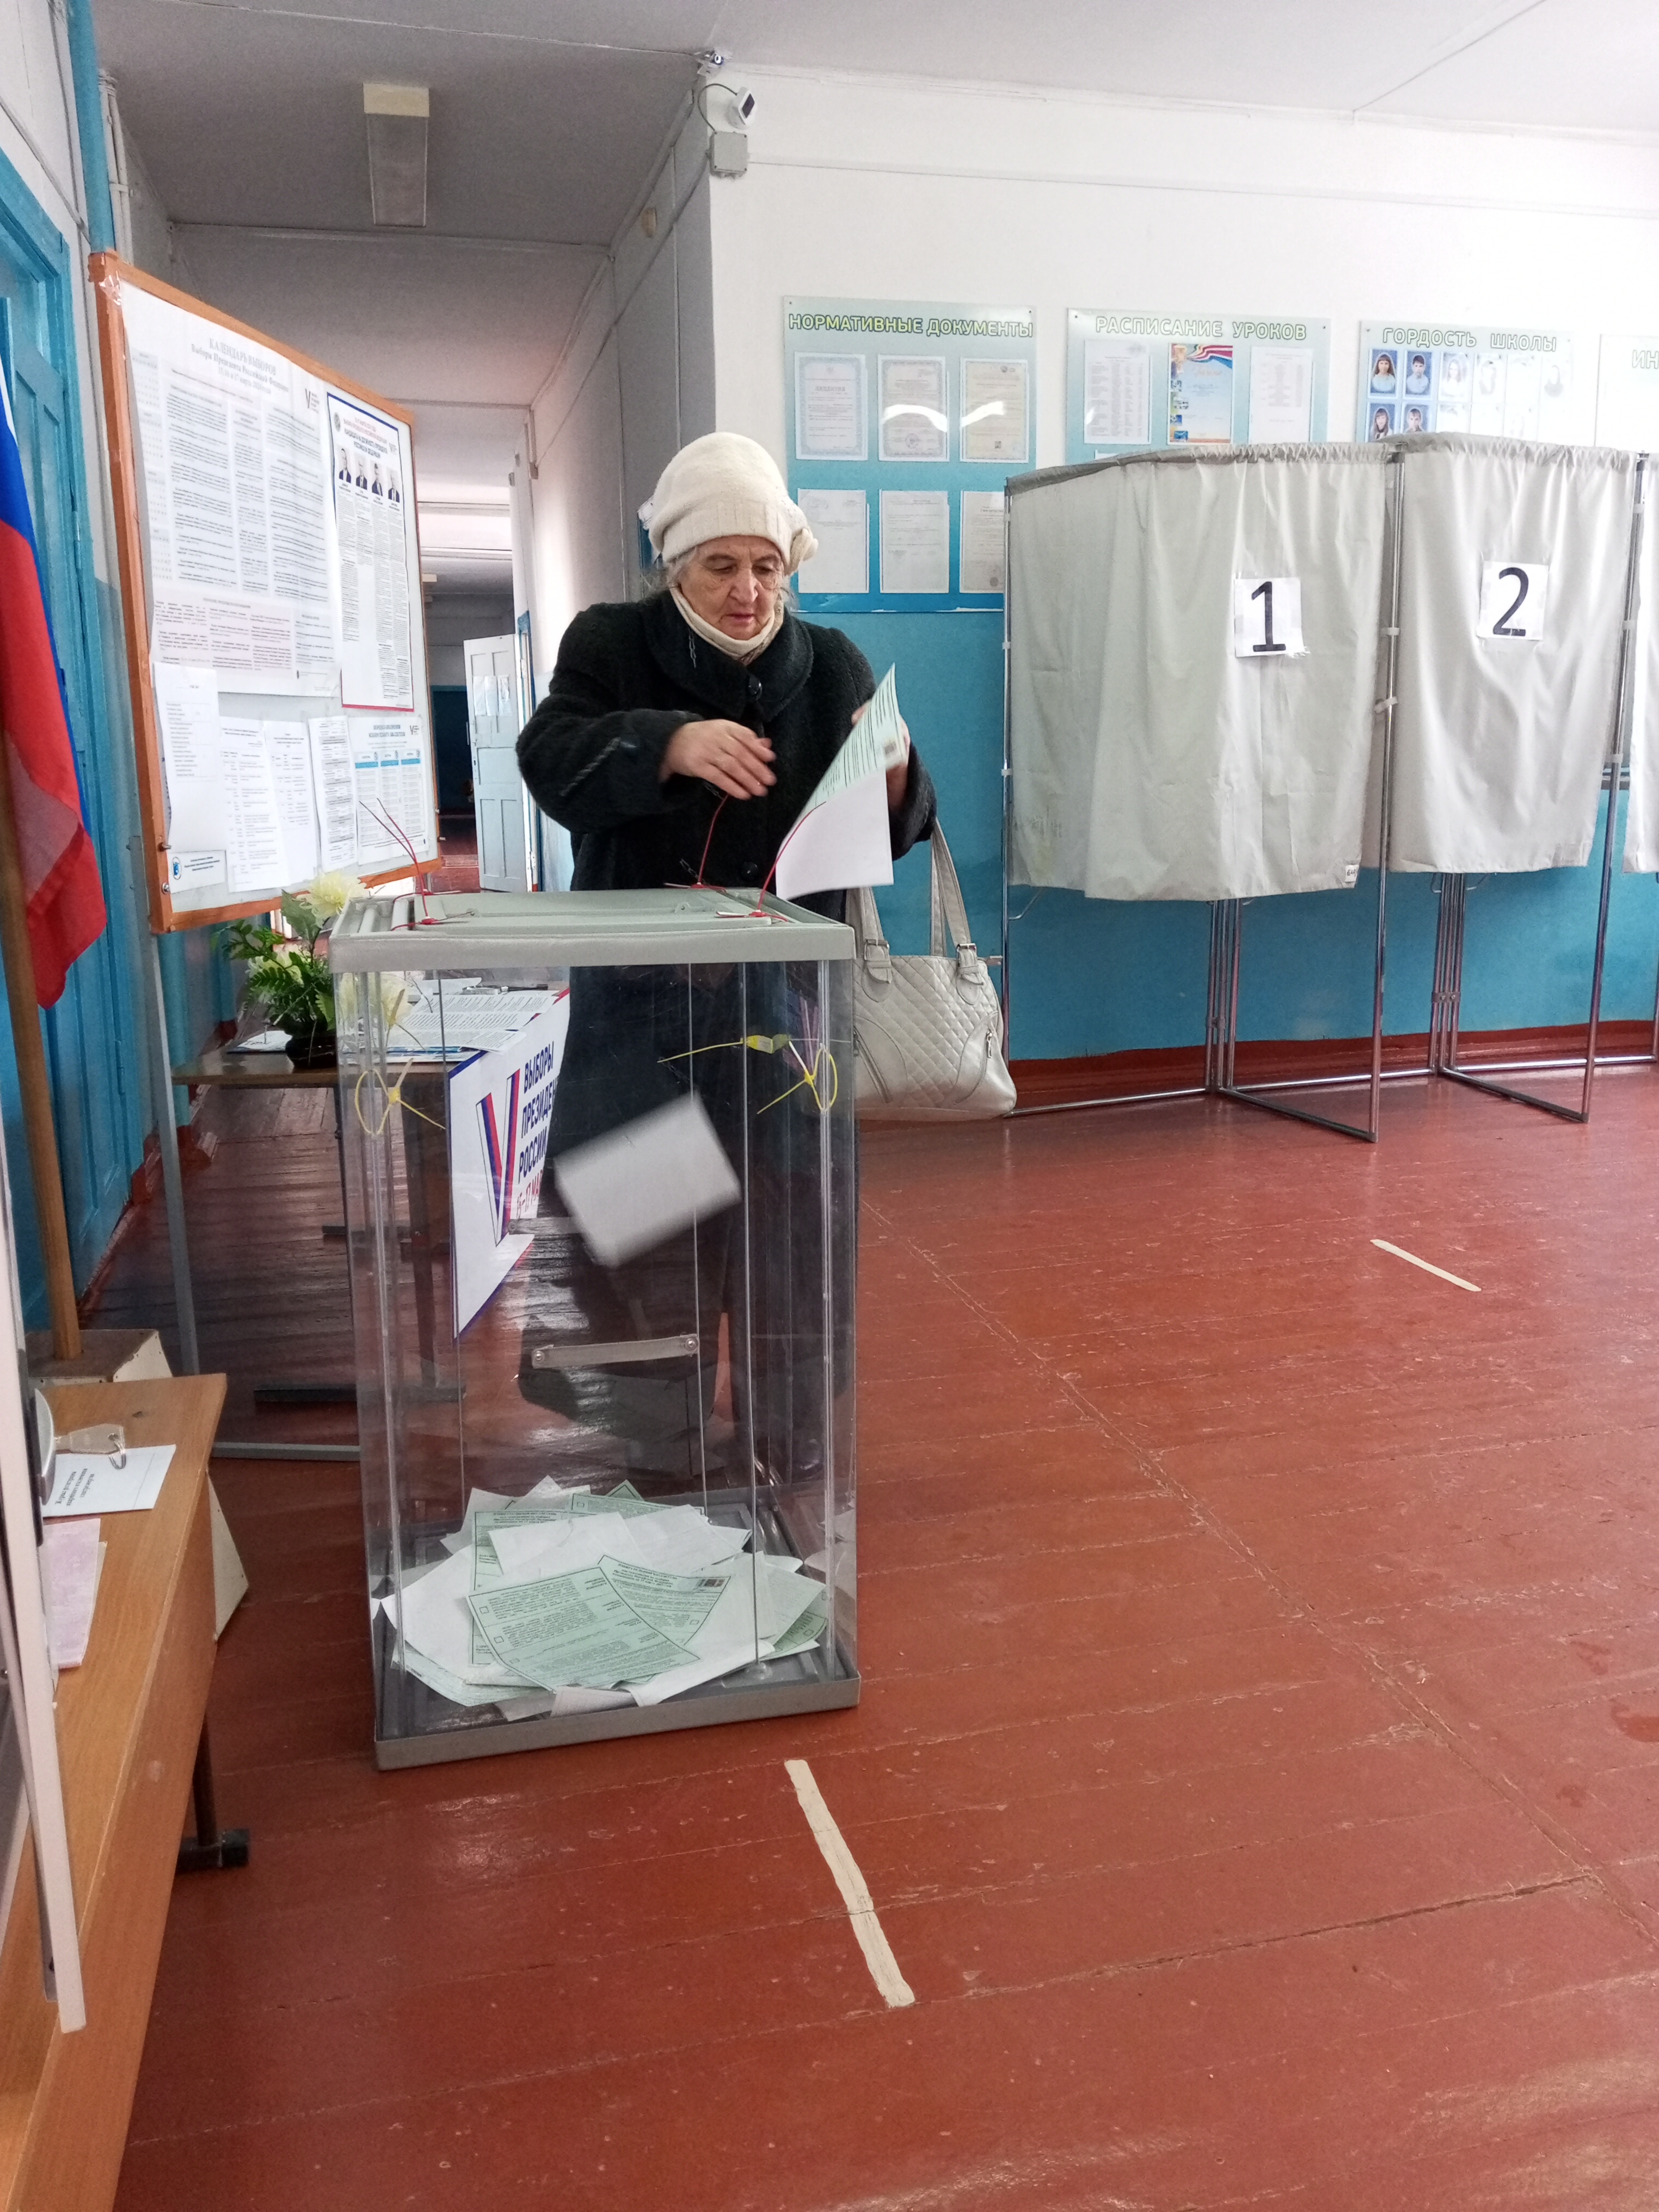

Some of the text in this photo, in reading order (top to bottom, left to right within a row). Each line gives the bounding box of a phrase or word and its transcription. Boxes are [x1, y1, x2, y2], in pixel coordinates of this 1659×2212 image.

[789, 314, 1033, 337] НОРМАТИВНЫЕ ДОКУМЕНТЫ
[1096, 316, 1307, 340] РАСПИСАНИЕ УРОКОВ
[1382, 328, 1557, 352] ГОРДОСТЬ ШКОЛЫ
[1251, 581, 1286, 652] 1
[1492, 567, 1529, 636] 2
[524, 1041, 554, 1094] ВЫБОРЫ
[521, 1076, 558, 1139] ПРЕЗИДЕН
[518, 1126, 547, 1184] РОССИИ
